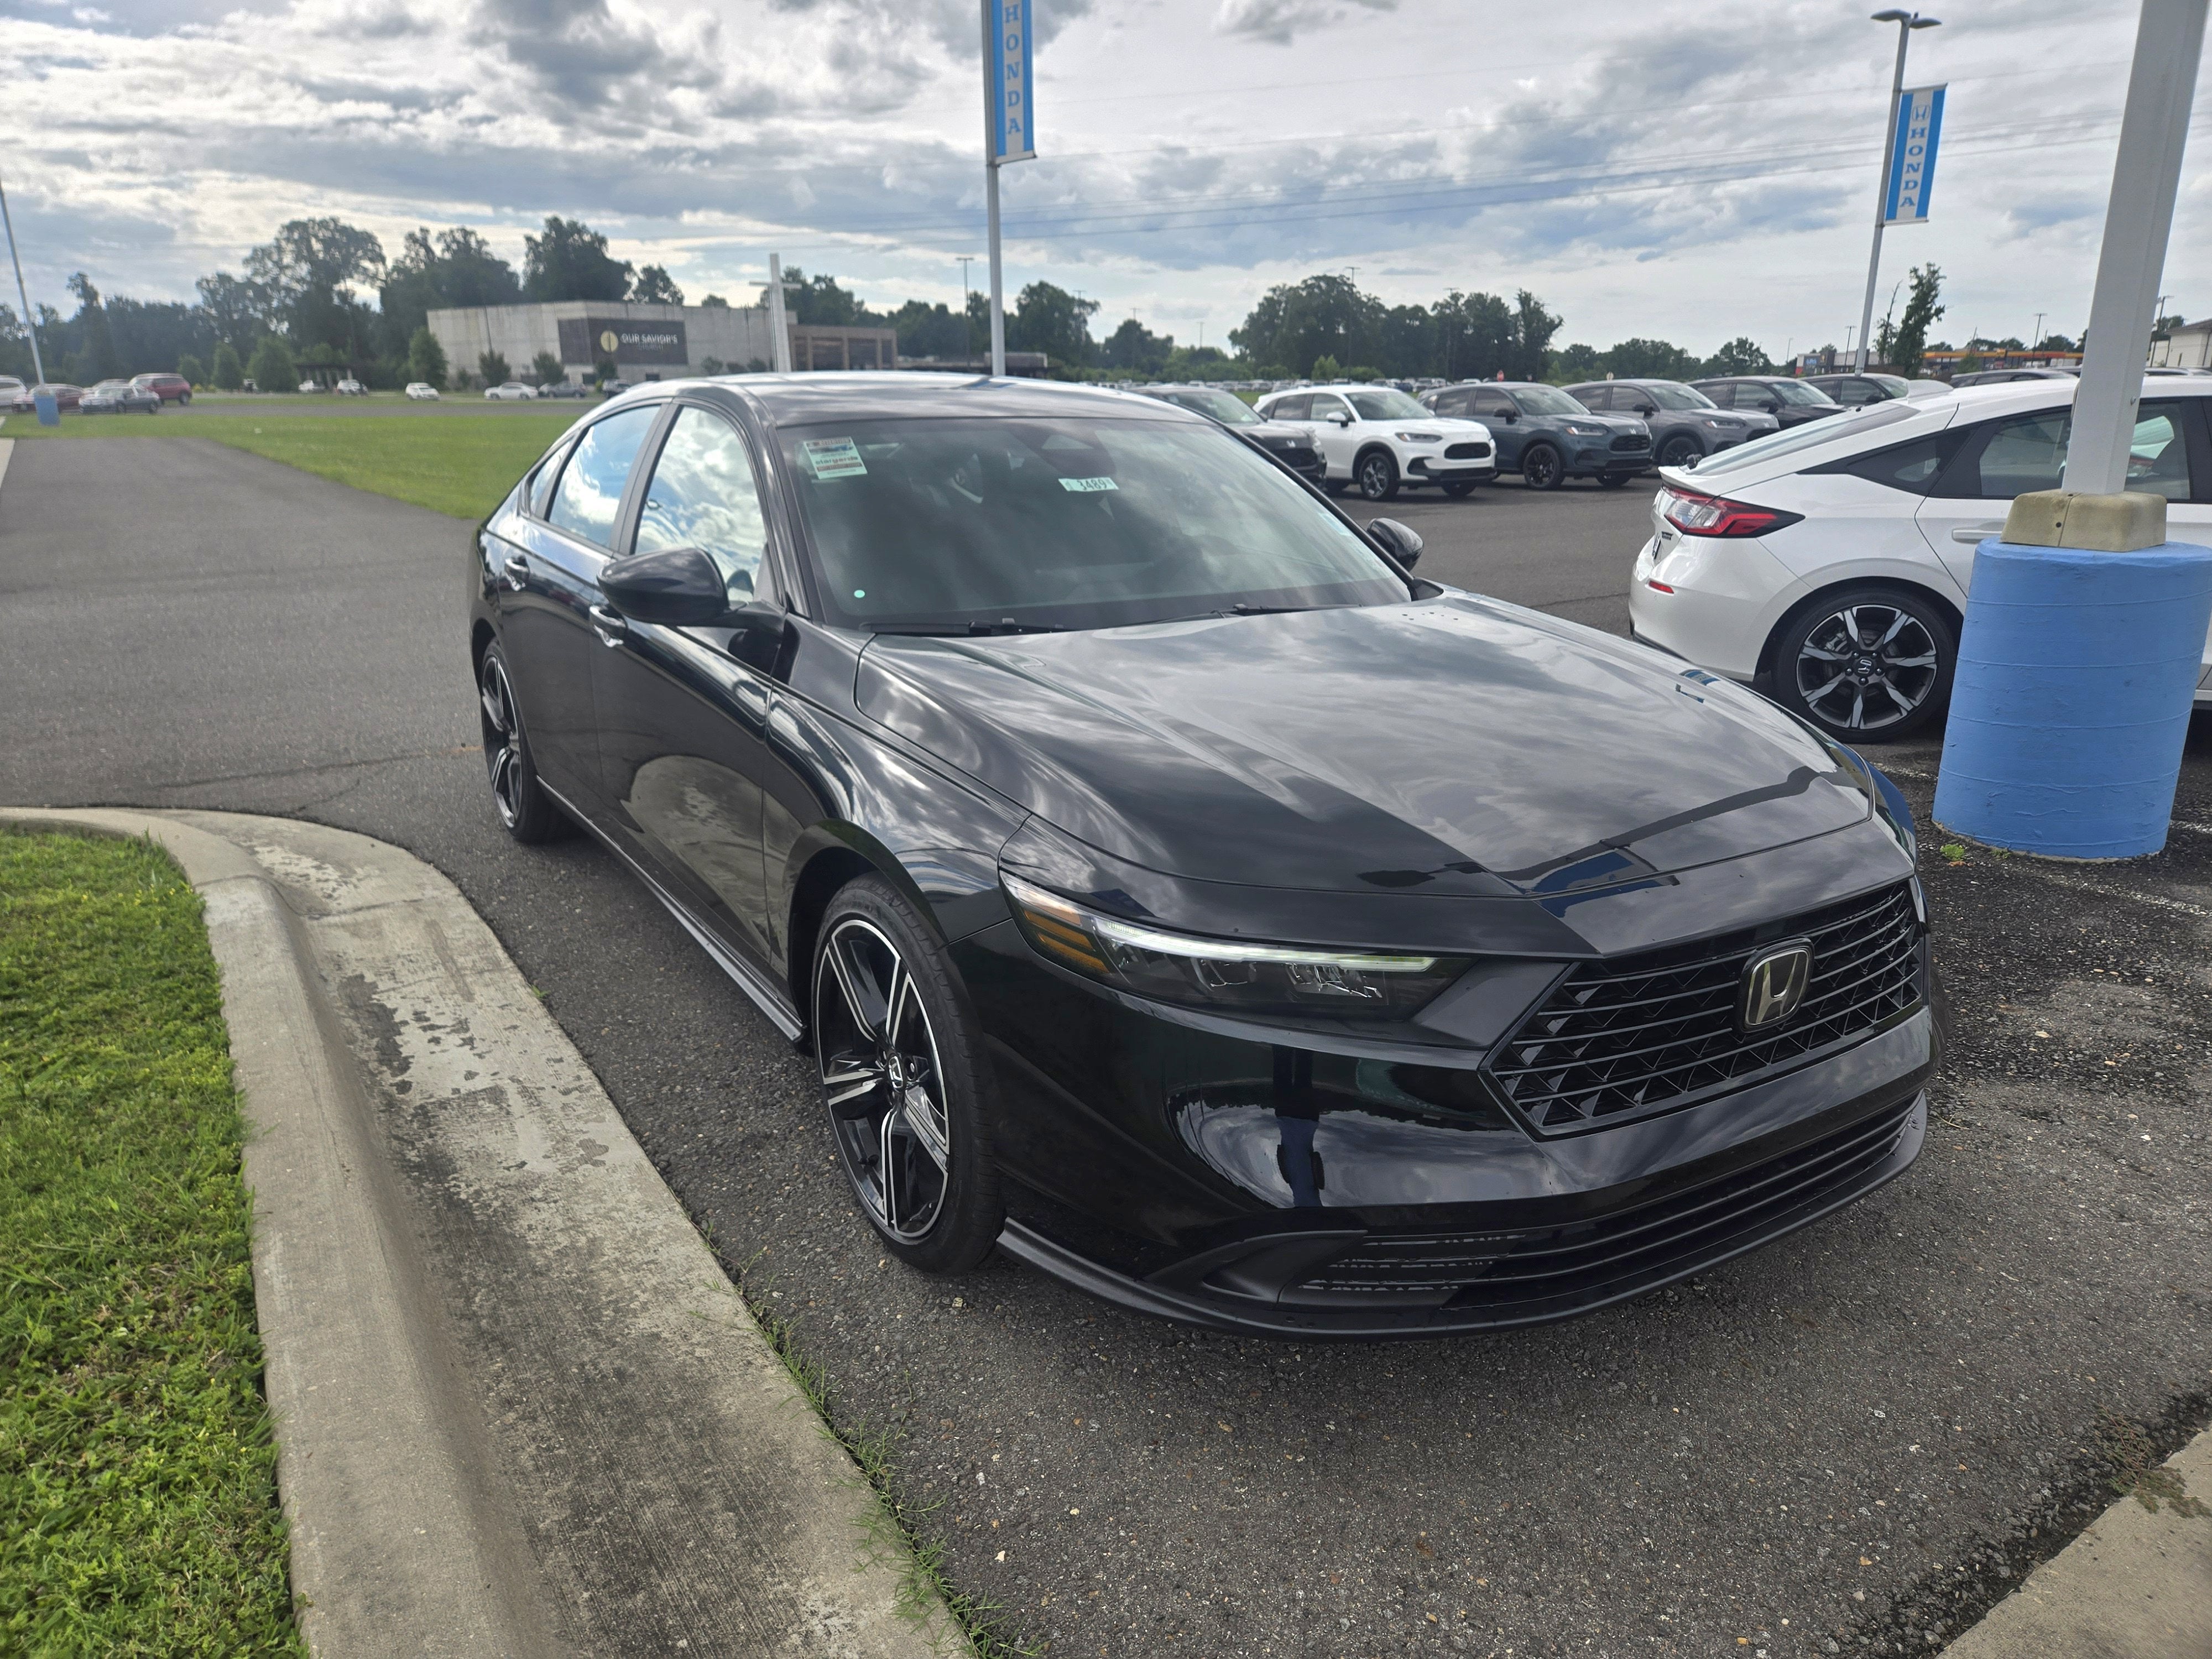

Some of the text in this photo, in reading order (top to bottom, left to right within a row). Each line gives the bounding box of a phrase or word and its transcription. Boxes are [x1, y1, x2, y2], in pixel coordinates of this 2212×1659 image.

[1004, 4, 1021, 135] HONDA
[1900, 127, 1927, 207] HONDA
[621, 333, 678, 345] OUR SAVIOR'S
[1076, 478, 1107, 491] 3489
